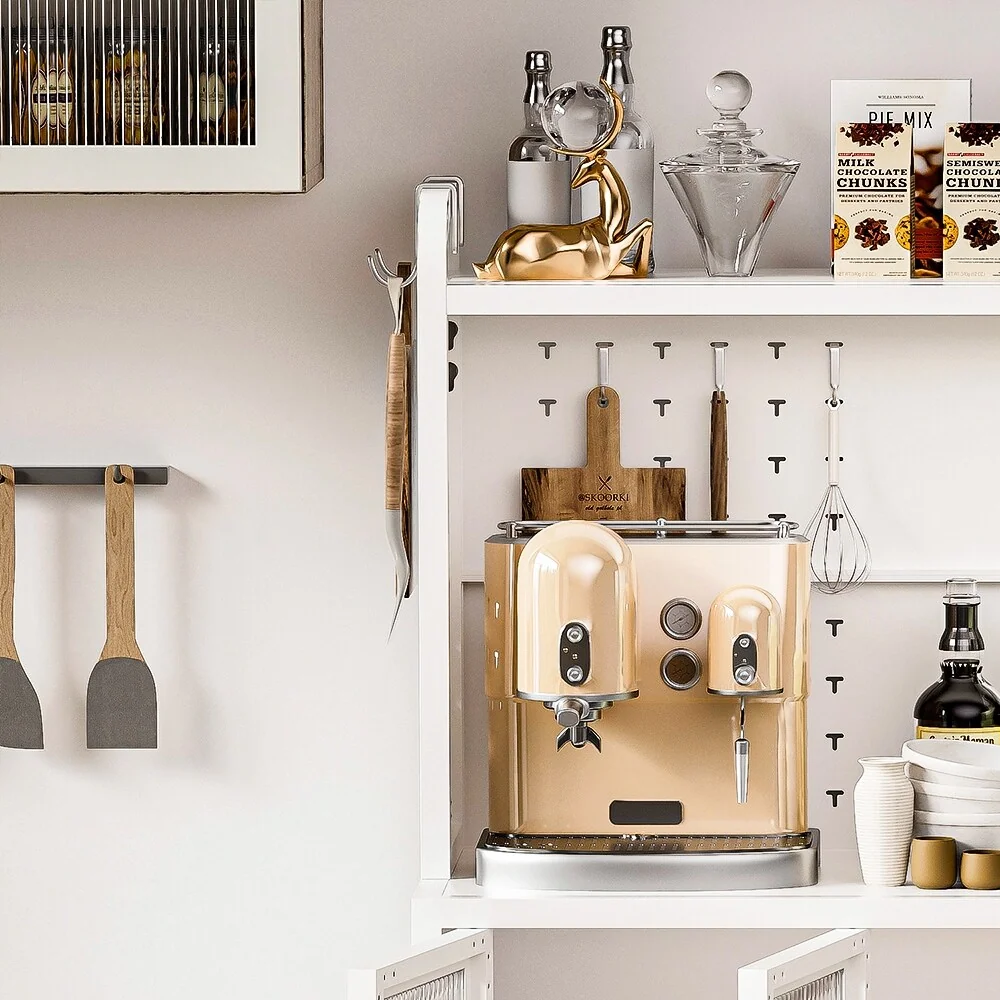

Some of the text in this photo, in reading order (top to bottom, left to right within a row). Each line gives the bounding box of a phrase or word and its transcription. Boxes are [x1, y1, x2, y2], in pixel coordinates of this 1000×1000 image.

[904, 111, 932, 128] MIX
[837, 158, 875, 167] MILK
[837, 168, 908, 176] CHOCOLATE
[836, 177, 908, 188] CHUNKS
